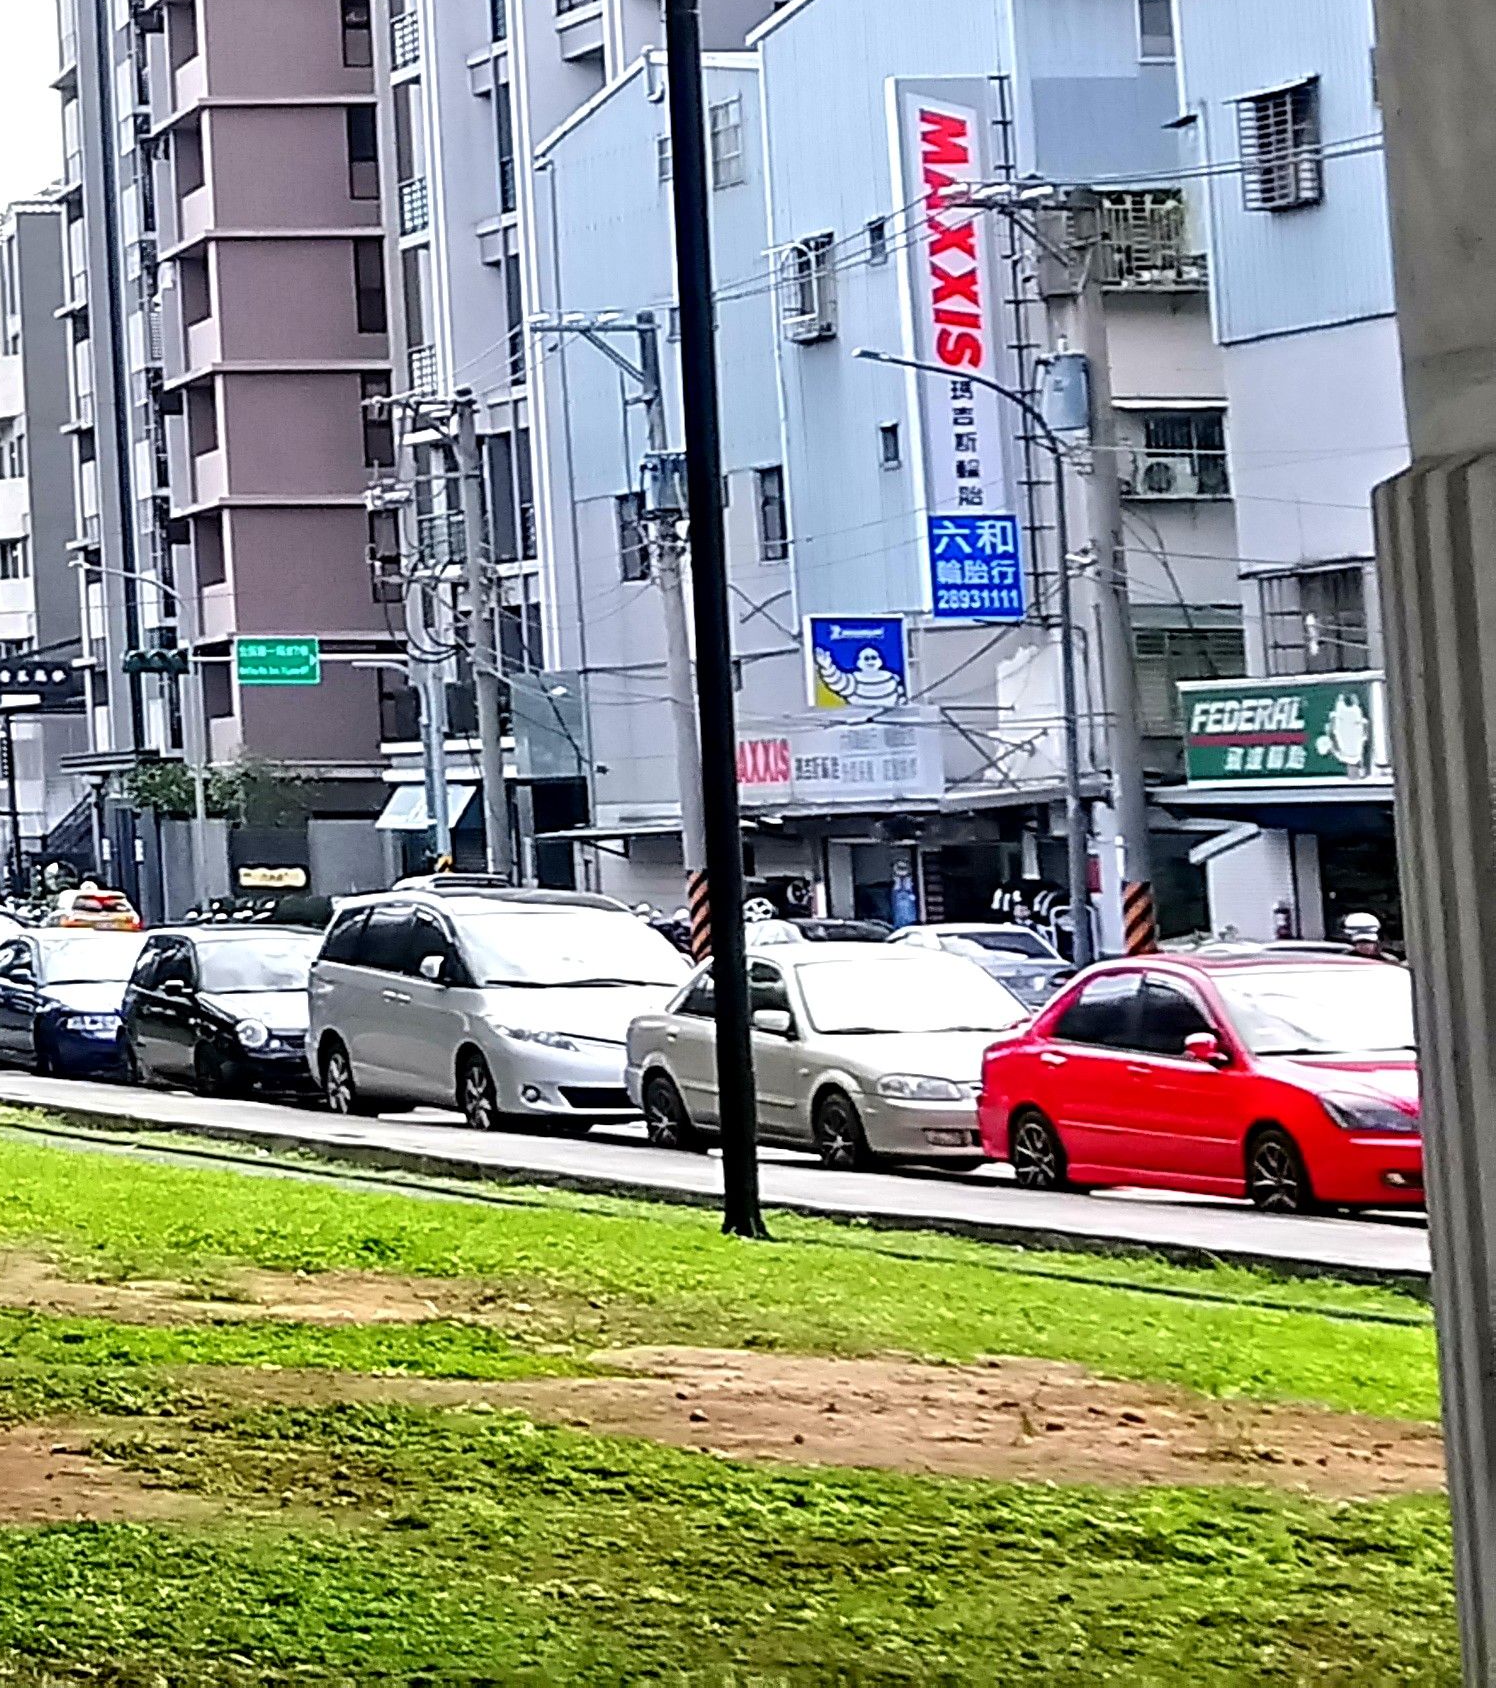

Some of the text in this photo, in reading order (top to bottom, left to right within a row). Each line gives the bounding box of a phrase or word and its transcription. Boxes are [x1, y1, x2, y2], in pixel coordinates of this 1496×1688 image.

[919, 108, 982, 369] MAXXIS
[932, 519, 1015, 555] 六和
[936, 559, 1016, 585] 輪胎行
[937, 589, 1019, 609] 28931111
[1190, 696, 1305, 733] FEDERAL
[736, 739, 791, 783] AXXIS
